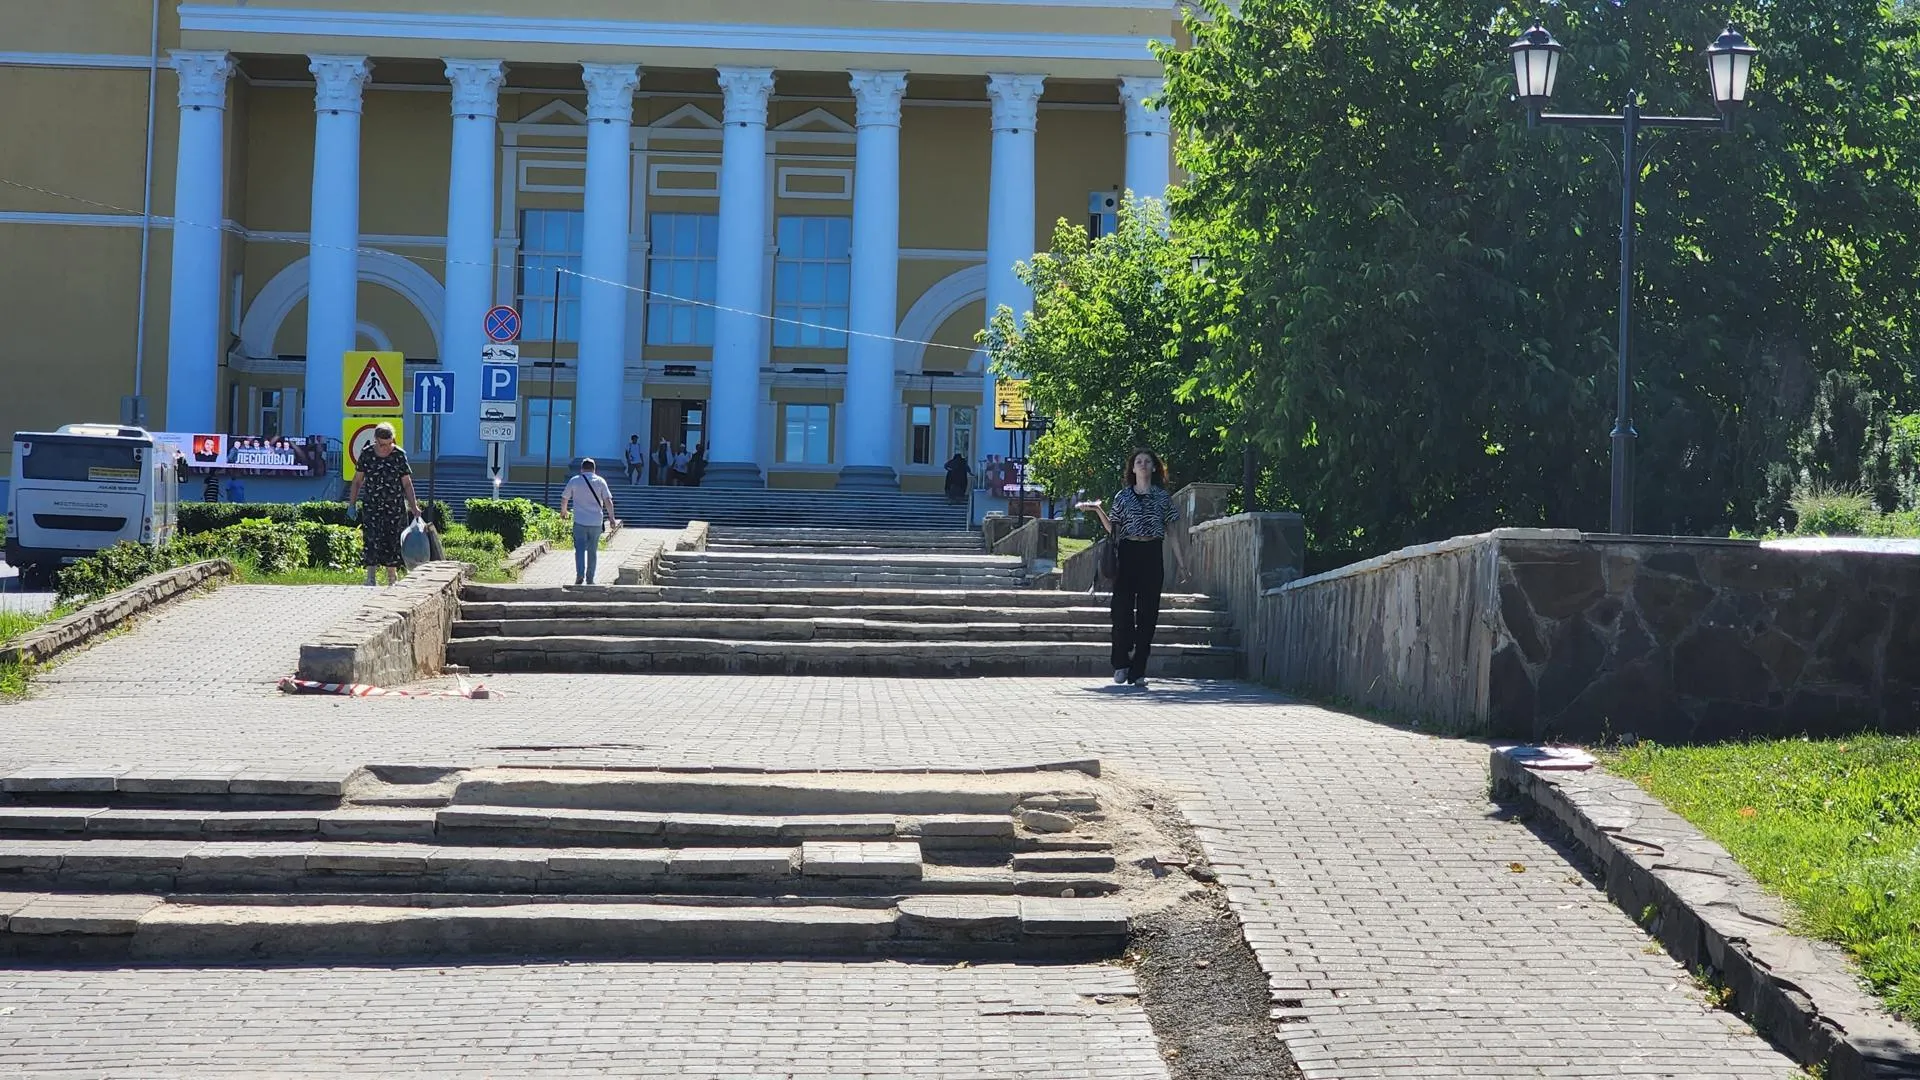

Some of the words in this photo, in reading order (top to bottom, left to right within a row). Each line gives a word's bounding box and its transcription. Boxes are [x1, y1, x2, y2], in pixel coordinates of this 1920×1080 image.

[491, 369, 511, 397] P
[501, 427, 512, 436] 20
[235, 453, 295, 466] ЛЕСОПОВАЛ
